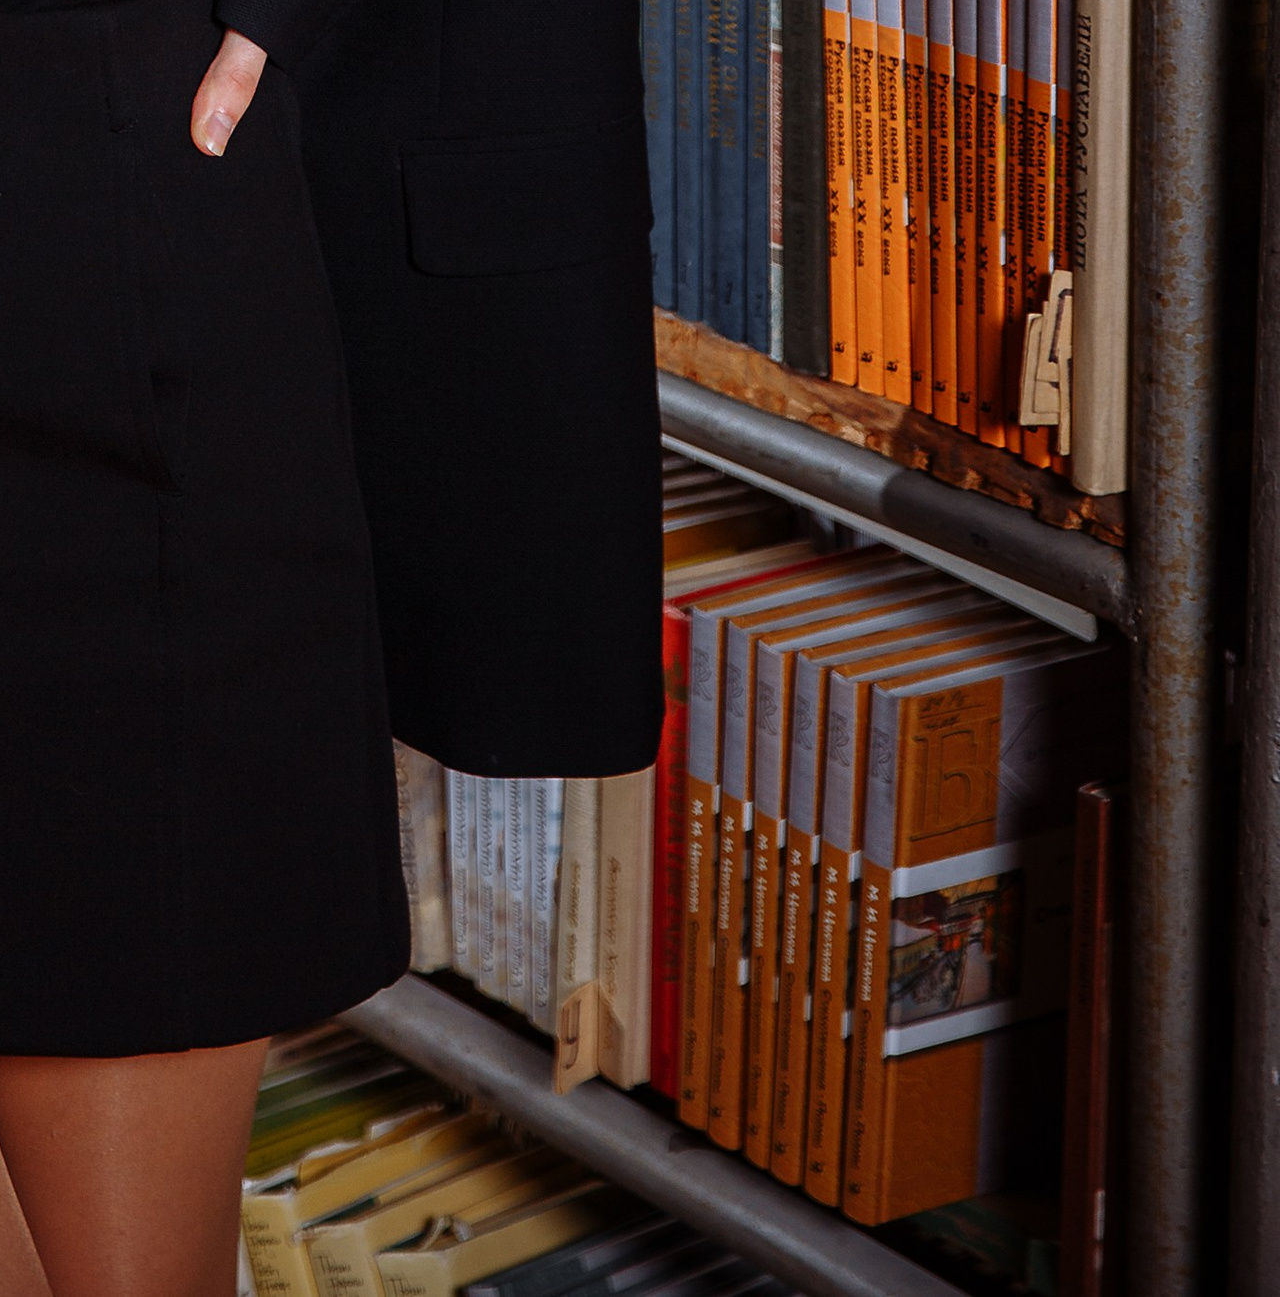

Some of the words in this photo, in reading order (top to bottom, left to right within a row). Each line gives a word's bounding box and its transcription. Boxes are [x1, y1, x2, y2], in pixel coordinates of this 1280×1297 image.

[862, 48, 873, 113] Русская
[887, 56, 899, 121] Русская
[1075, 14, 1092, 175] РУСТАВЕЛИ
[865, 118, 874, 175] поэзия
[890, 127, 900, 183] поэзия
[1074, 189, 1088, 272] ШОТА
